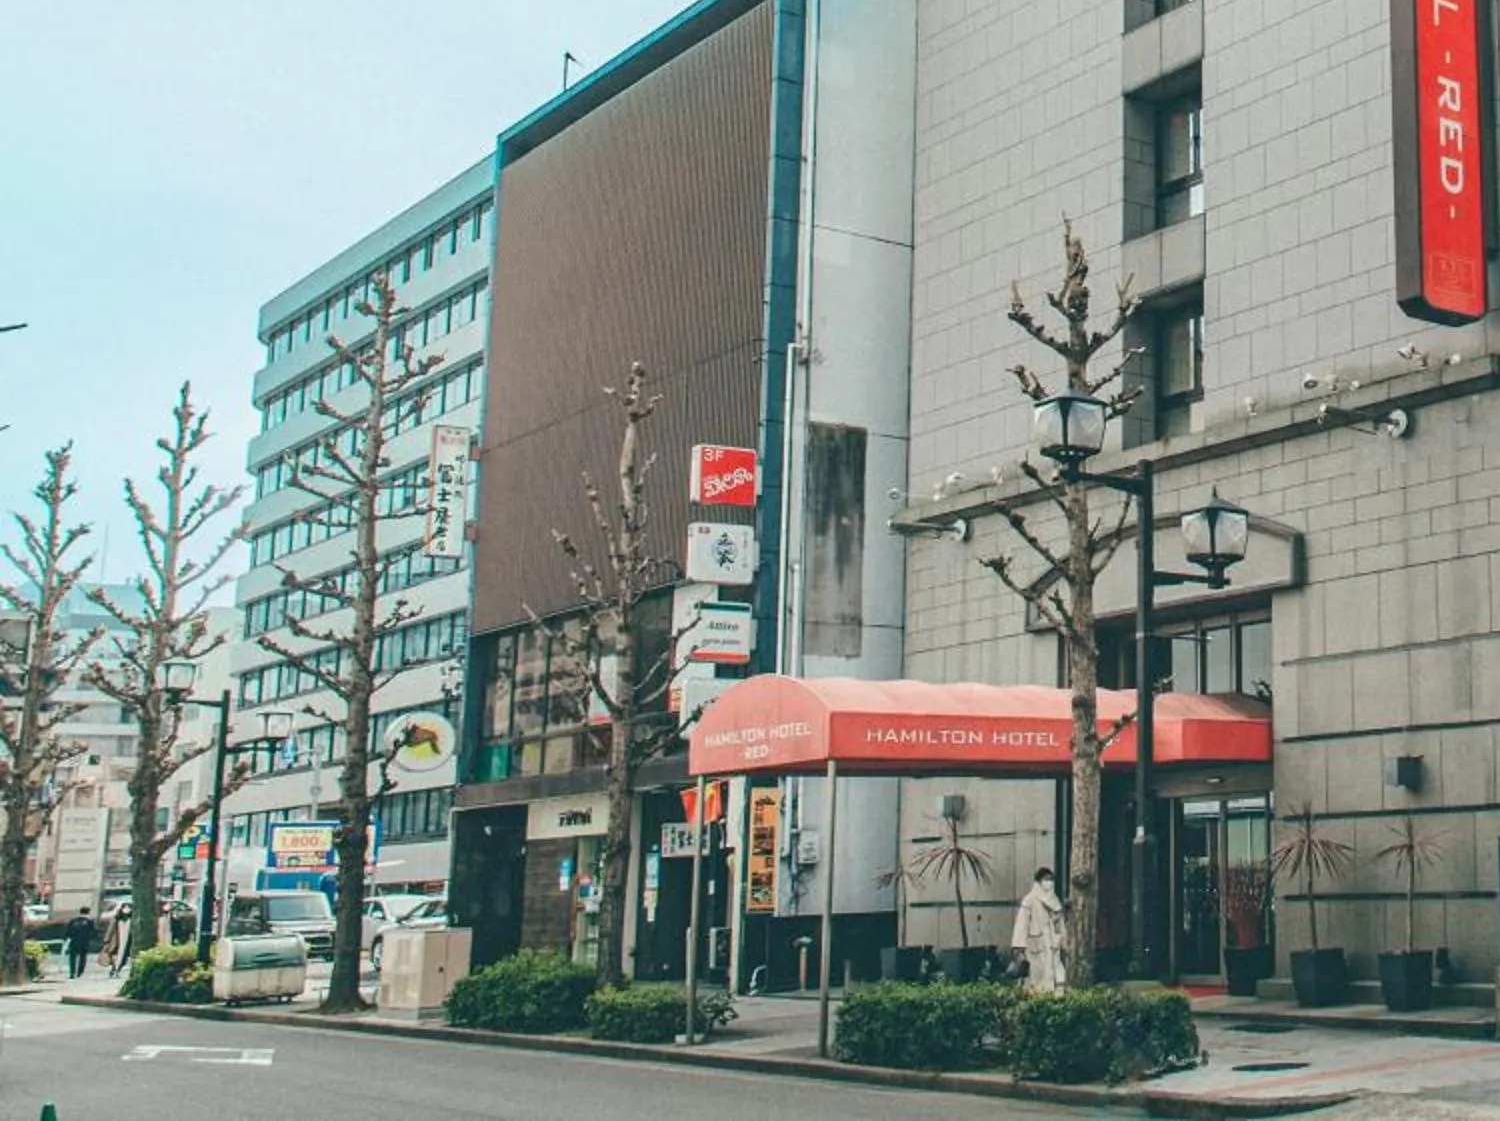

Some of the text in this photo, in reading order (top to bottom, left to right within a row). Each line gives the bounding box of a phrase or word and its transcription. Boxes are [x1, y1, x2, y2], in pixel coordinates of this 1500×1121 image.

[703, 447, 725, 462] 3F
[704, 722, 814, 748] HAMILTON HOTEL
[866, 729, 1060, 747] HAMILTON HOTEL
